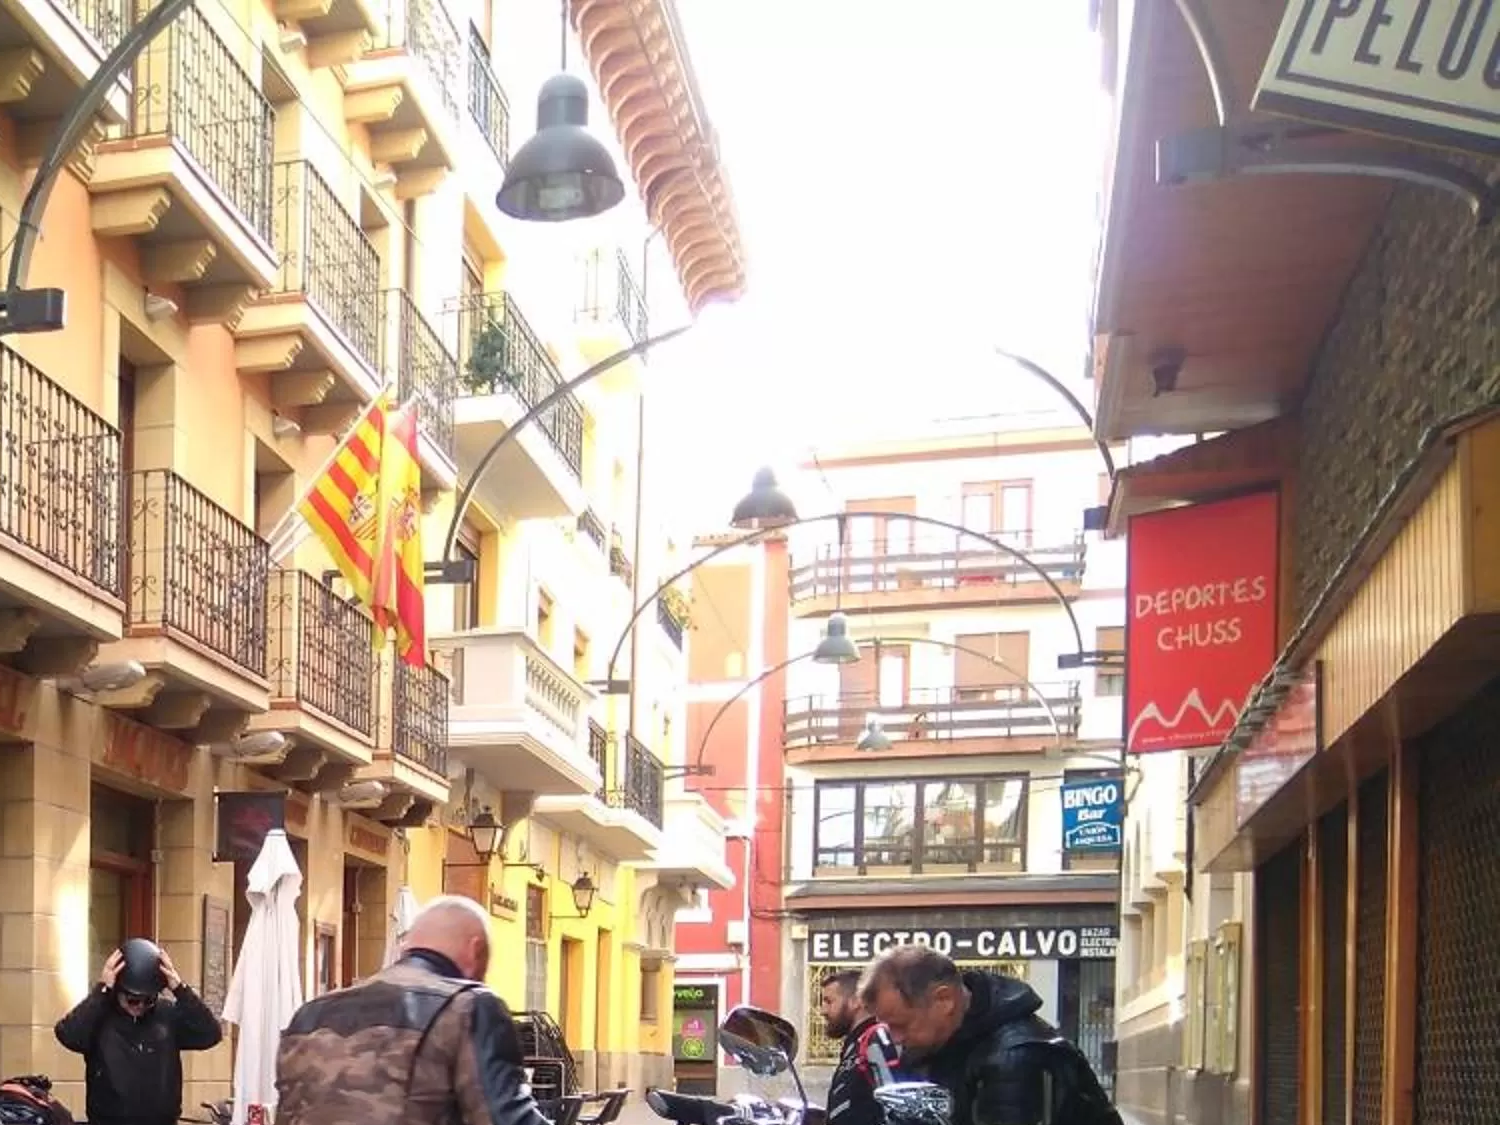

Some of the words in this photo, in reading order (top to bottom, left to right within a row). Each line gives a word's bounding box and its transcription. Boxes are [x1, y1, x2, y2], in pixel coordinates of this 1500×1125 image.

[1309, 0, 1500, 90] PELU
[1134, 575, 1267, 619] DEPORTES
[1156, 616, 1243, 652] CHUSS
[1063, 783, 1117, 809] BINGO
[1077, 808, 1108, 821] Bar
